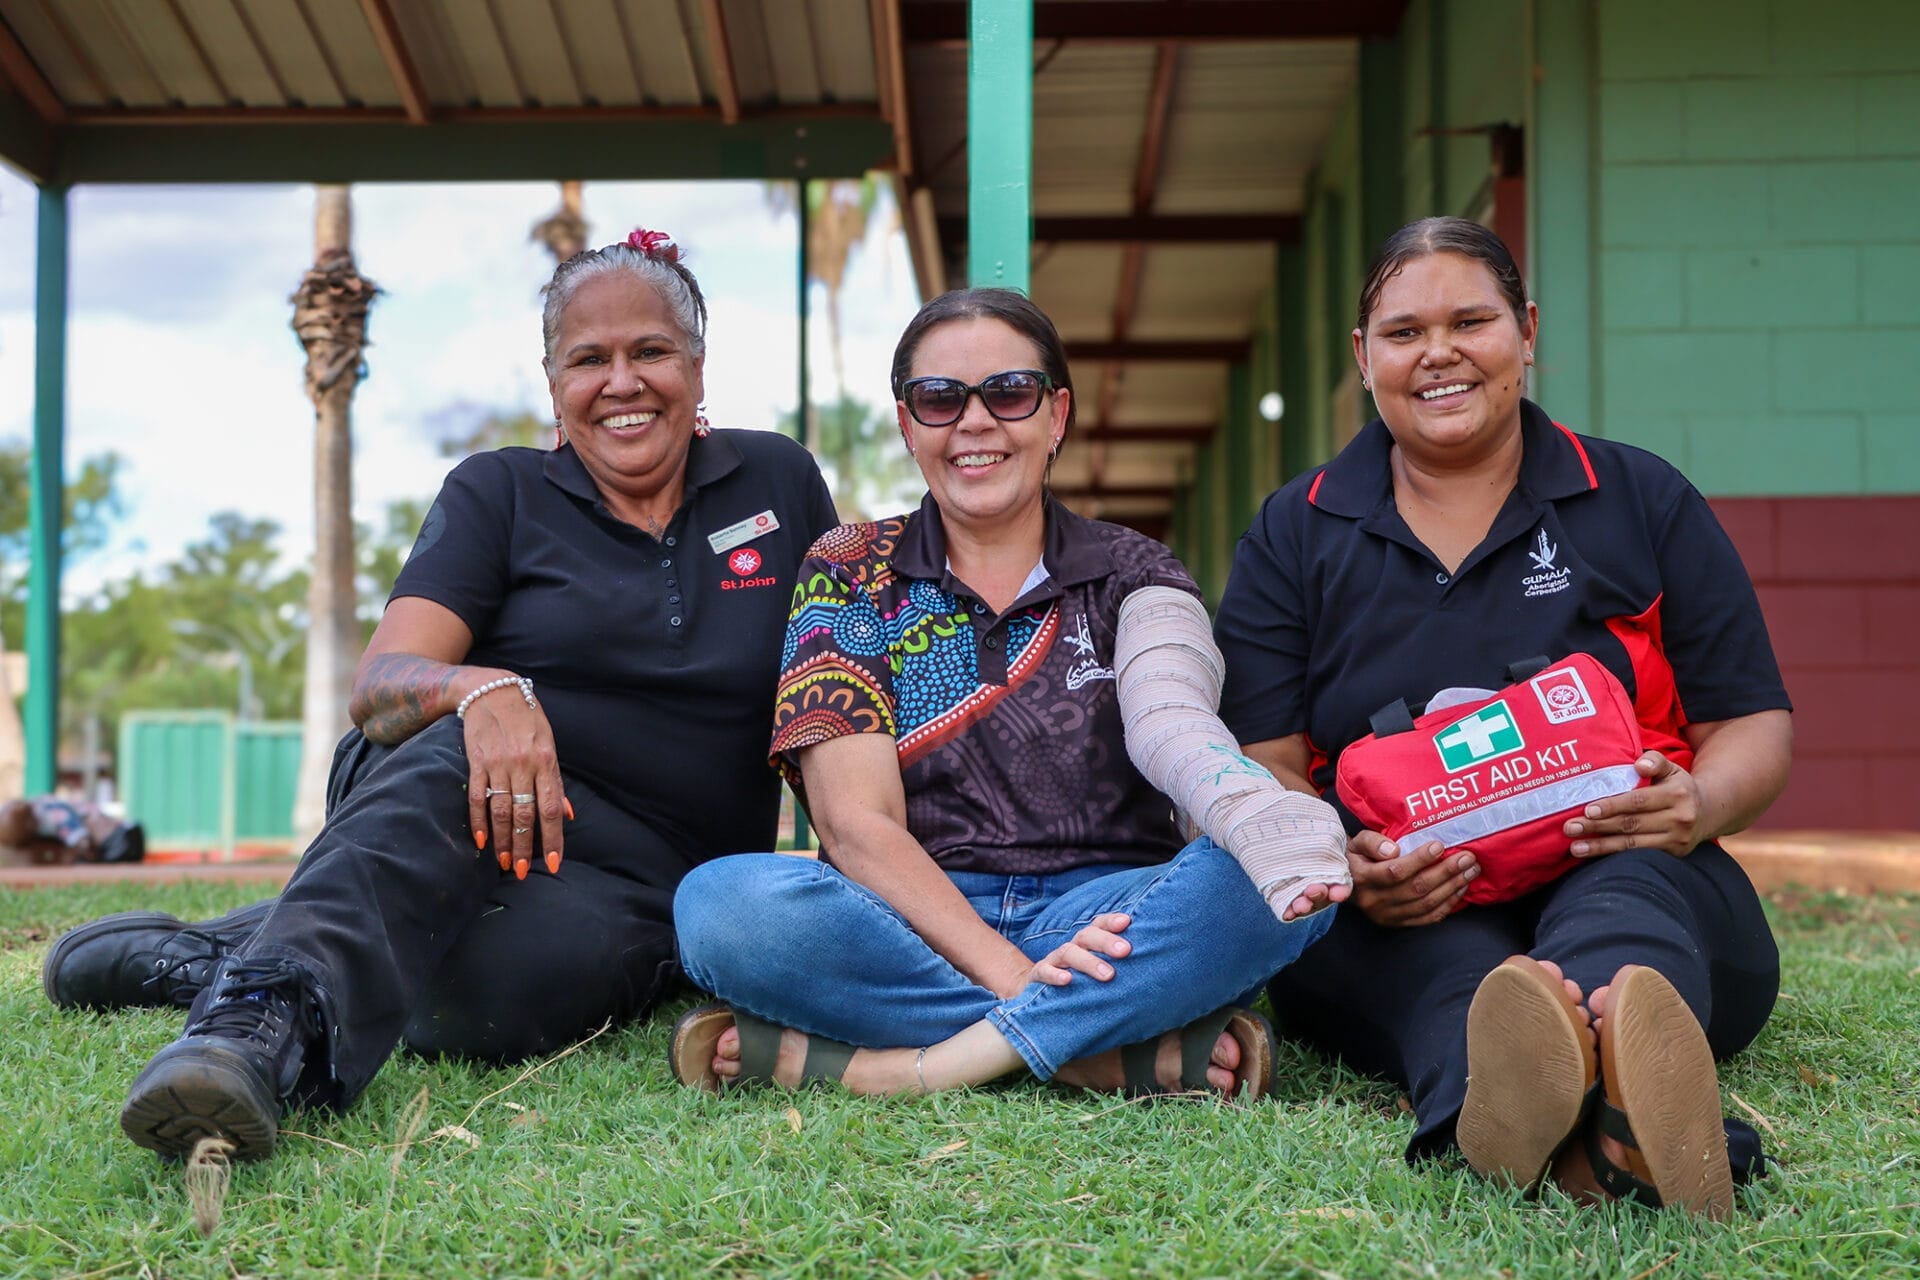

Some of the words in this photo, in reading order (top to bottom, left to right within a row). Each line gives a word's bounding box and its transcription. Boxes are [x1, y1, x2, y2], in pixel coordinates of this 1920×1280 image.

[720, 580, 737, 591] St
[739, 576, 777, 589] John
[1522, 567, 1572, 585] GUMALA
[1553, 711, 1565, 719] St
[1566, 705, 1590, 717] John
[1405, 771, 1480, 817] FIRST
[1490, 756, 1533, 788] AID
[1535, 739, 1579, 771] KIT
[1412, 818, 1428, 829] CALL
[1428, 814, 1437, 823] ST
[1437, 808, 1455, 820] JOHN
[1453, 803, 1467, 813] FOR
[1466, 800, 1478, 809] ALL
[1477, 791, 1496, 804] YOUR
[1494, 787, 1513, 799] FIRST
[1513, 783, 1524, 793] AID
[1524, 776, 1546, 790] NEEDS
[1545, 774, 1556, 783] ON
